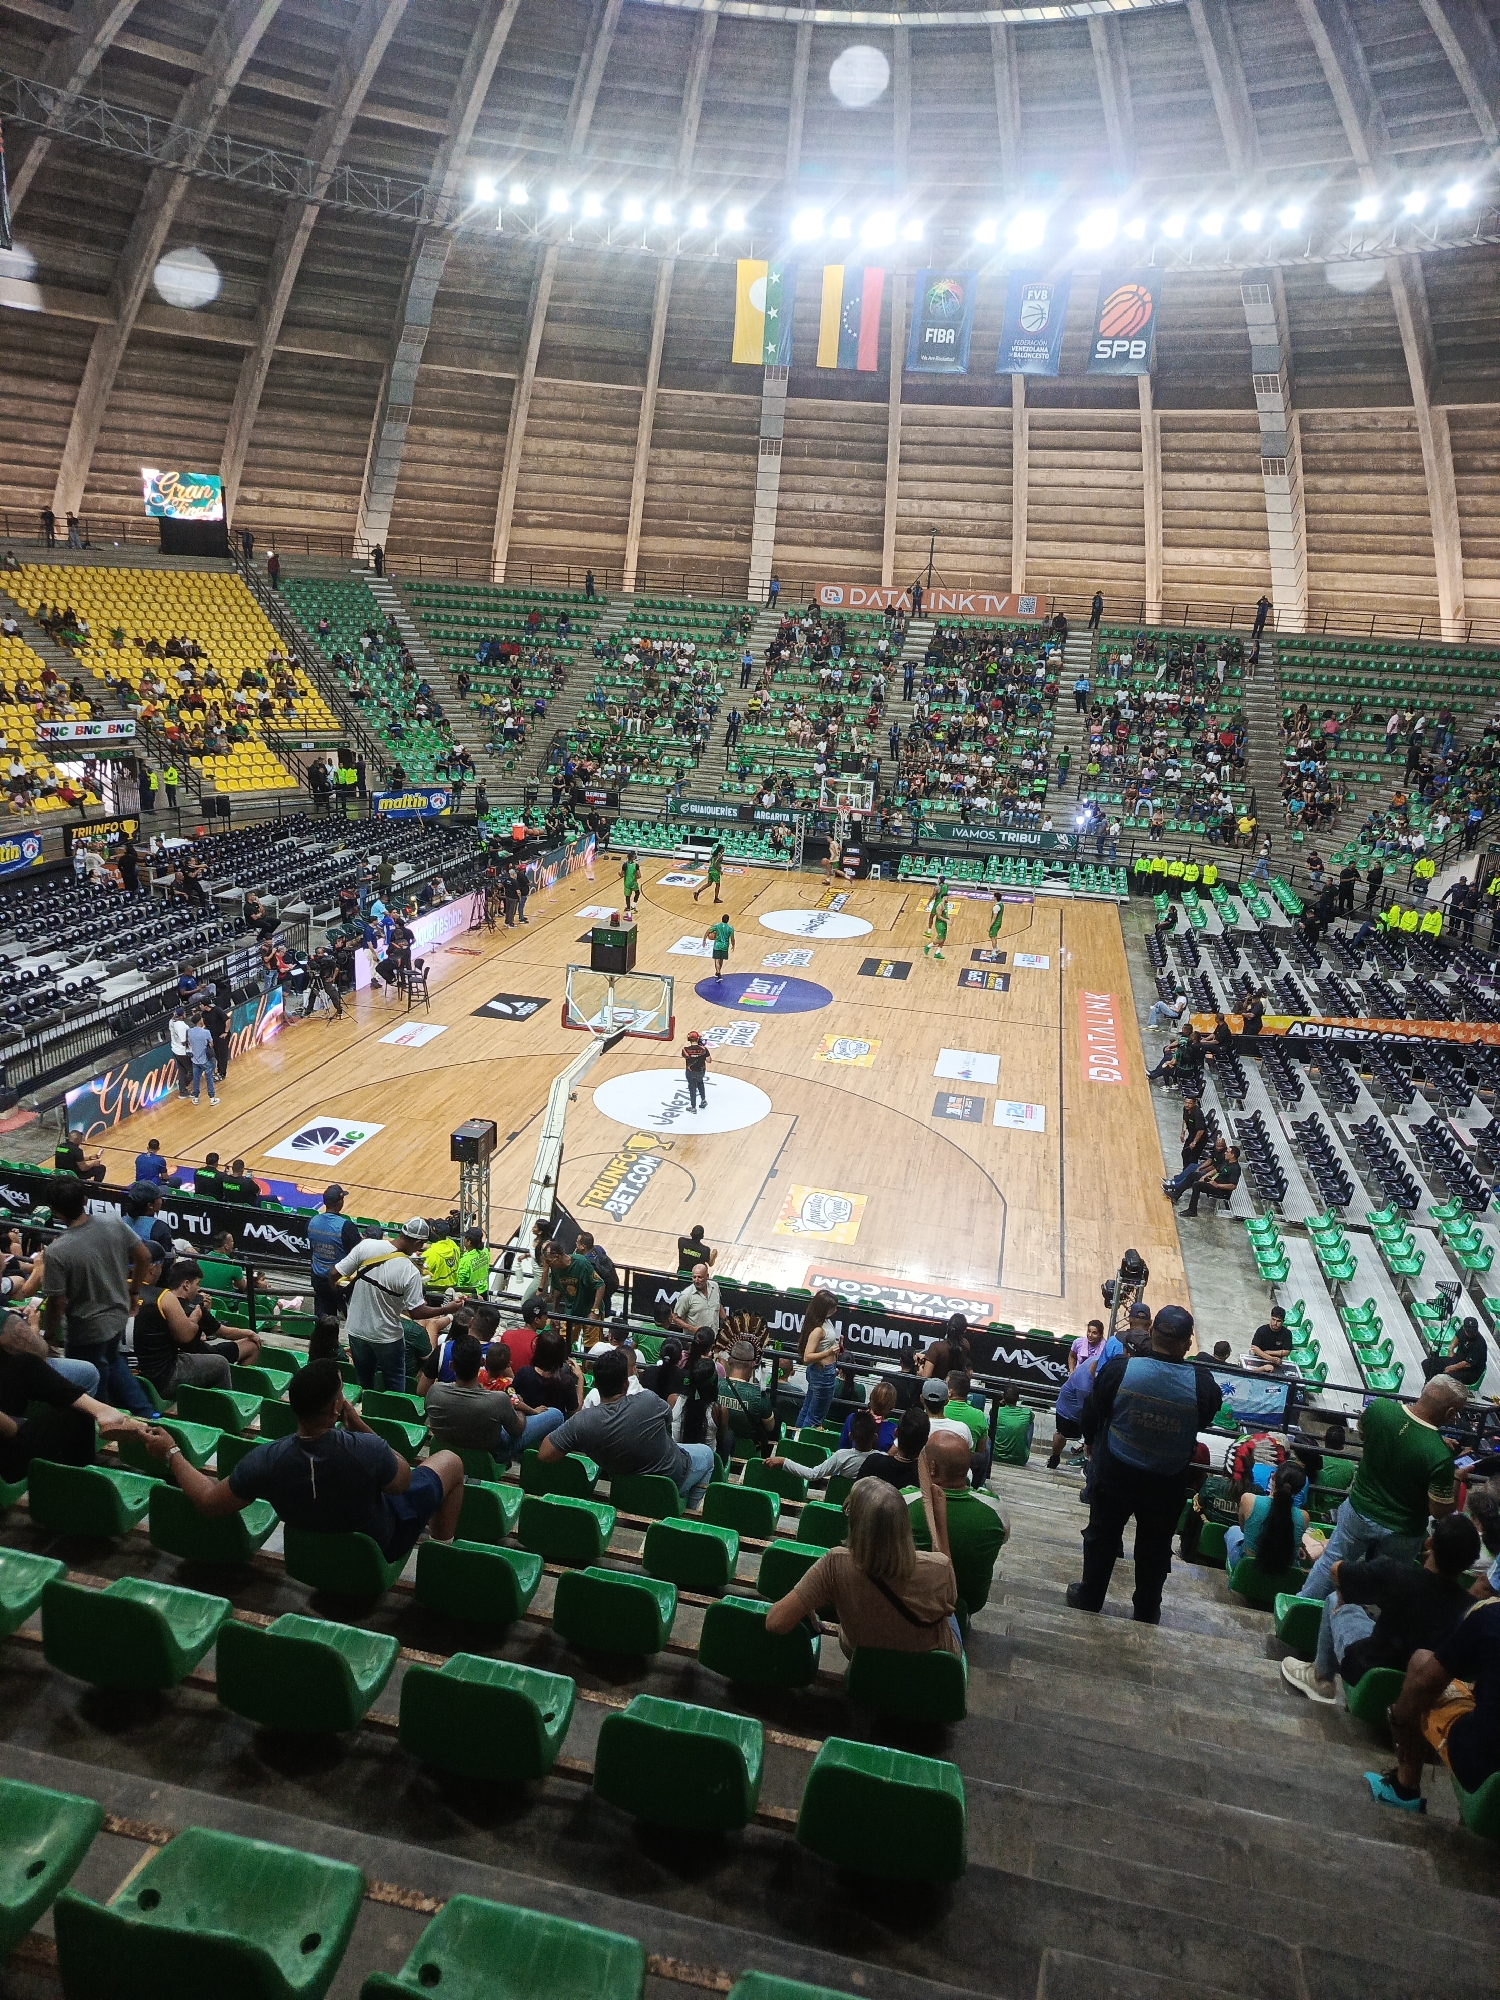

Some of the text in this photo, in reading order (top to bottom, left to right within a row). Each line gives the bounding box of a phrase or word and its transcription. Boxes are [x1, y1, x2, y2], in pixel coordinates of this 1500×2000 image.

[1027, 290, 1049, 300] FVB
[925, 327, 956, 344] FIBA
[1094, 340, 1147, 359] SPB
[149, 471, 214, 506] Gran
[978, 595, 1009, 613] TV
[41, 723, 134, 737] BNC BNC BNC
[378, 793, 428, 811] maltín
[690, 805, 738, 817] GUAIQUERÍES
[71, 822, 119, 838] TRIUNFO
[999, 831, 1042, 845] TRIBU!
[730, 1021, 756, 1047] pixel
[1084, 991, 1119, 1066] DATALINK
[323, 1130, 365, 1157] BNC
[580, 1152, 638, 1208] TRIUNFO
[603, 1154, 662, 1216] BET.COM
[805, 1194, 828, 1230] Apuestas
[183, 1212, 211, 1235] TÚ
[284, 1234, 311, 1250] 106.1
[812, 1275, 990, 1315] ROYAL.COM
